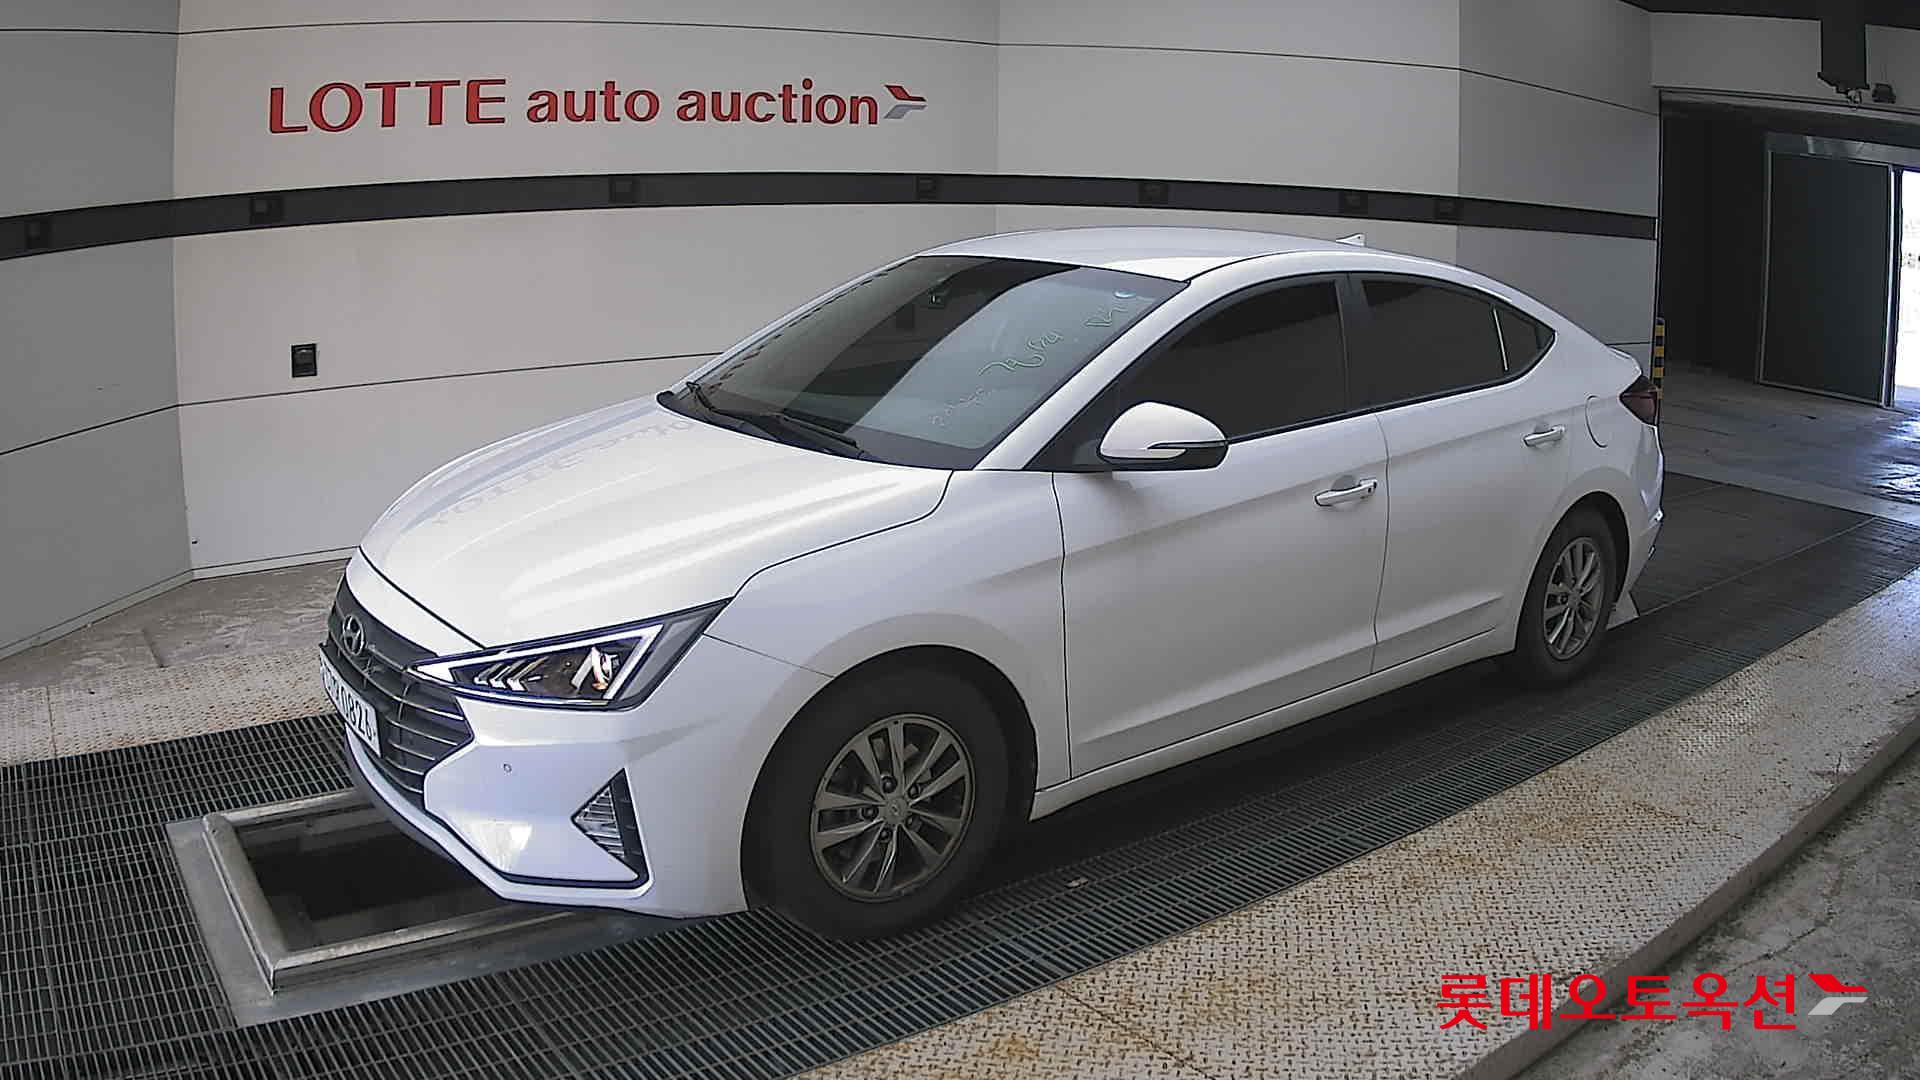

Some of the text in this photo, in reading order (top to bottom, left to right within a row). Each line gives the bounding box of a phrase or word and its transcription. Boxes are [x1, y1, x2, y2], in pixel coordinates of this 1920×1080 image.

[268, 77, 879, 134] LOTTE auto auction
